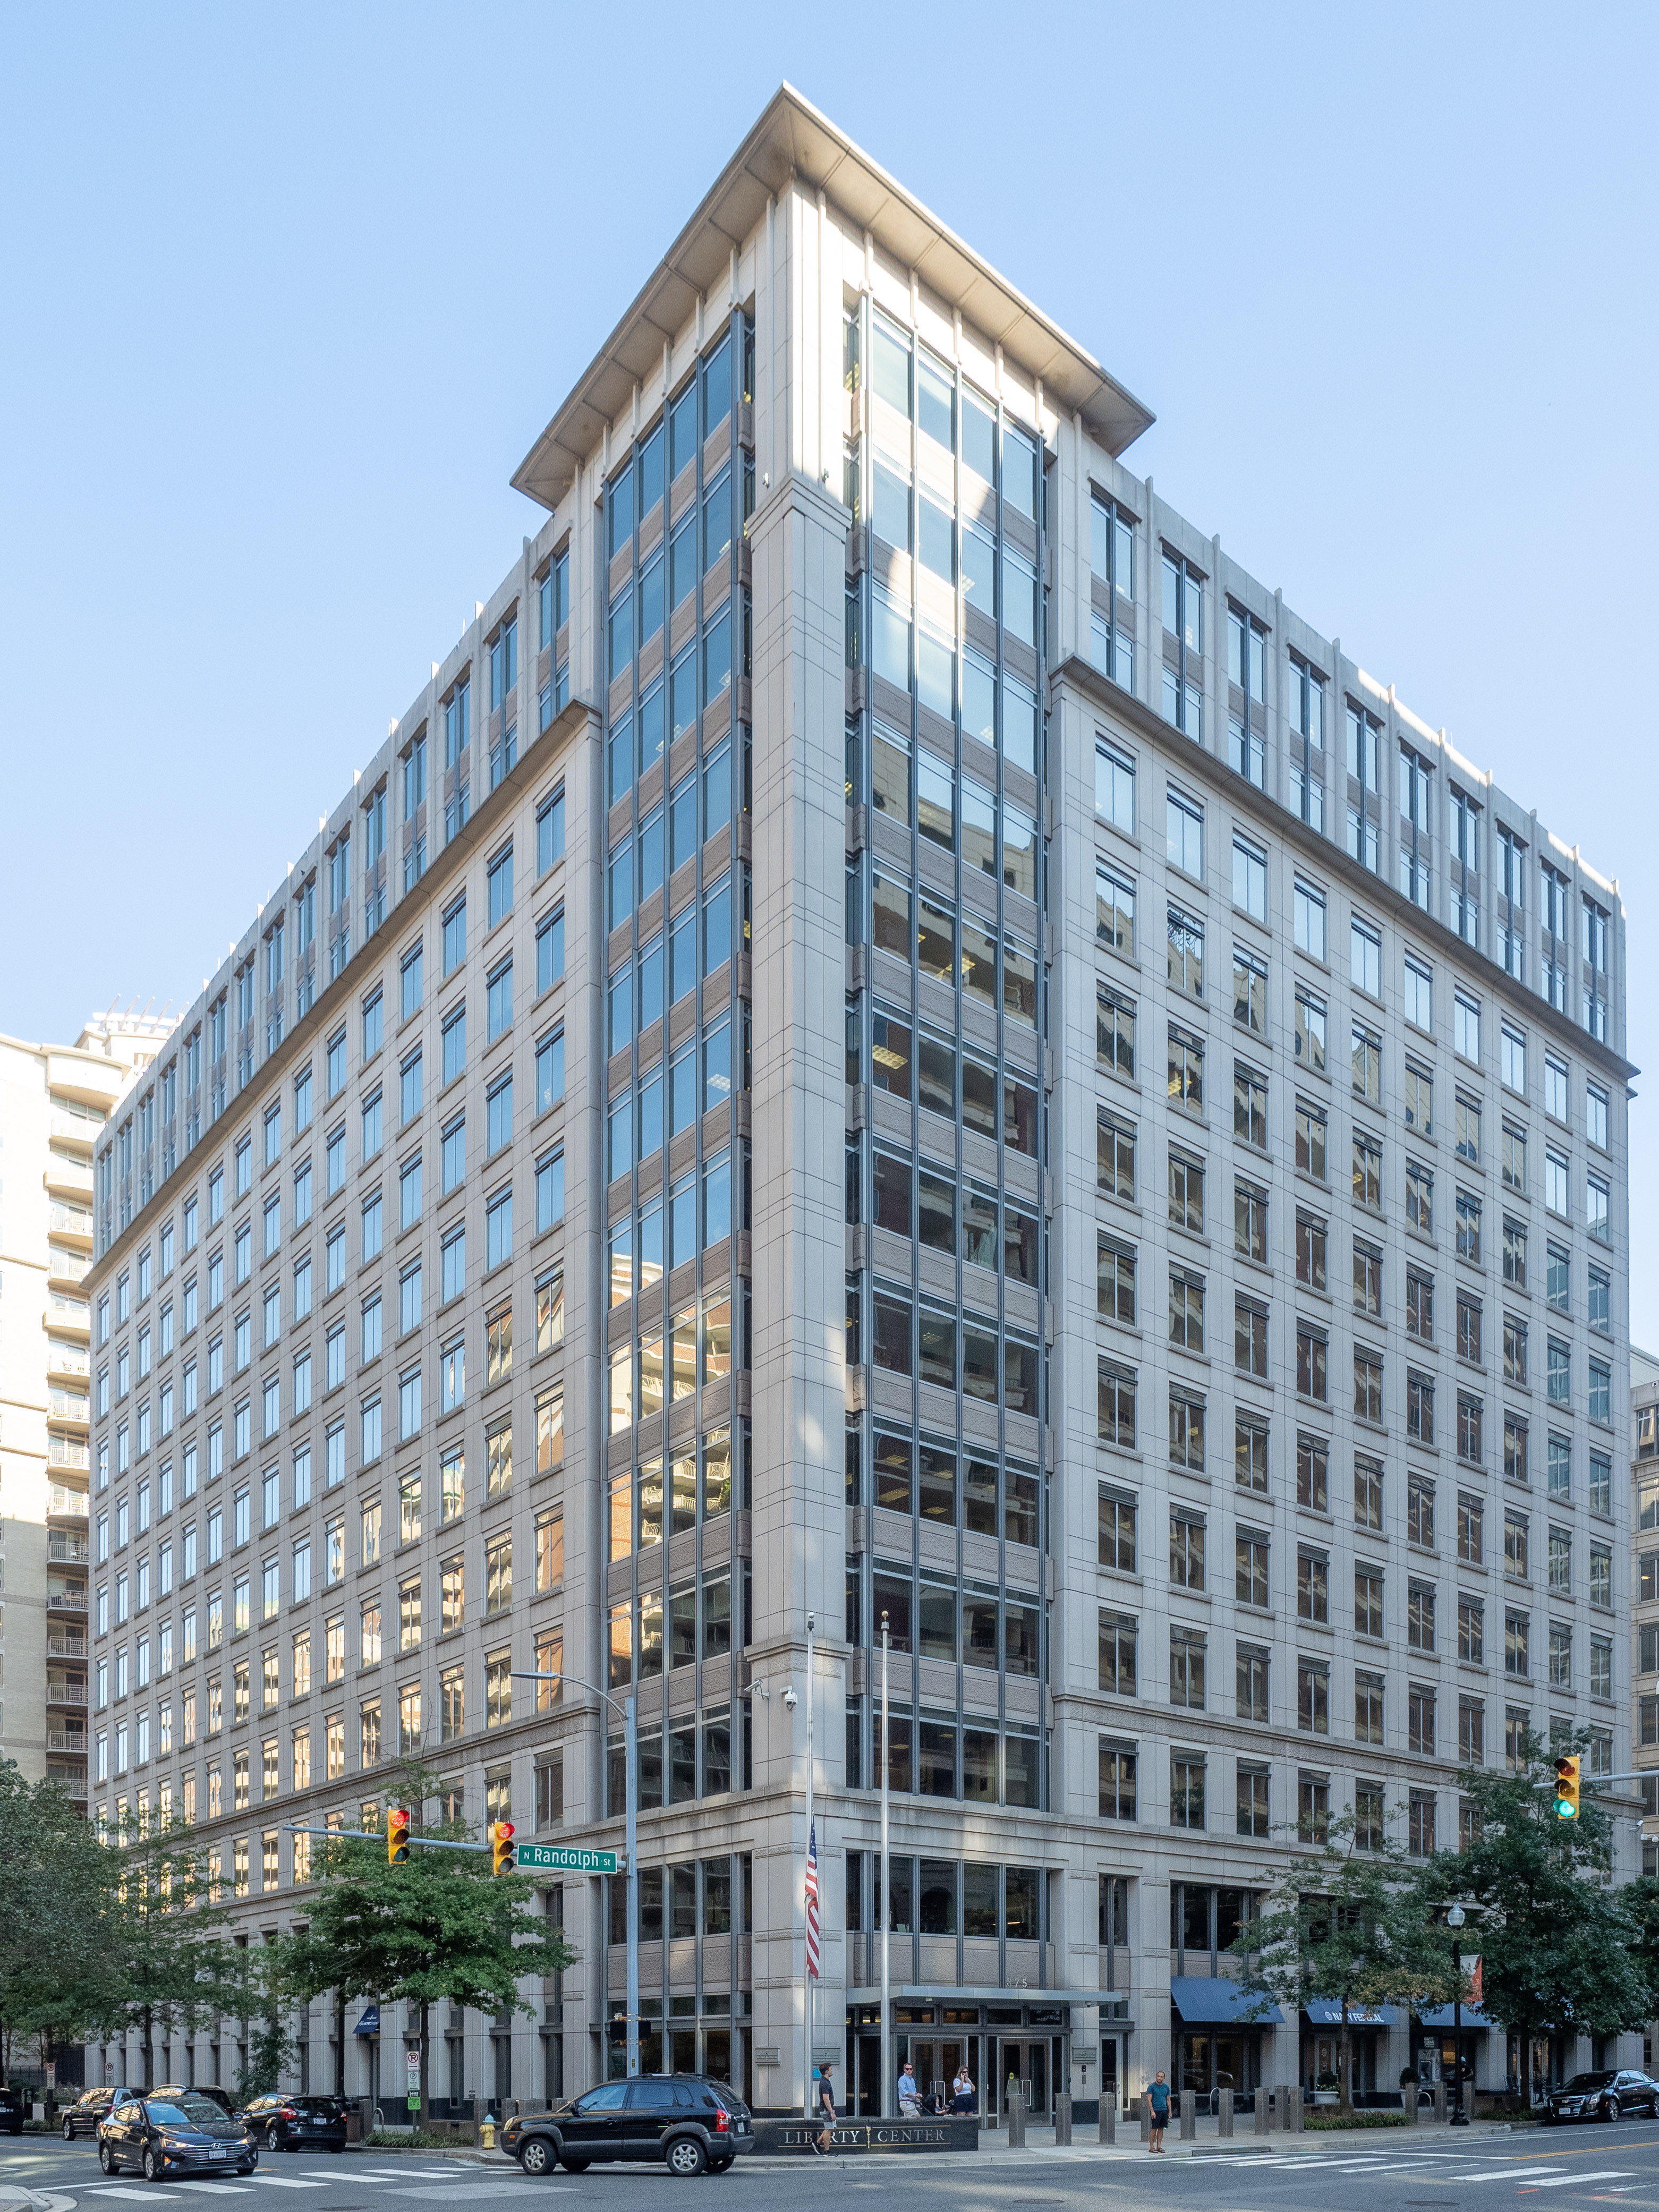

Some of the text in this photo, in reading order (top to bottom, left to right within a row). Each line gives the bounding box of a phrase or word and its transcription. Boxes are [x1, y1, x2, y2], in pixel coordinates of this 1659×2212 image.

[534, 1848, 599, 1869] Randolph
[1007, 1978, 1027, 1987] 875
[1332, 2012, 1353, 2021] NAY
[878, 2129, 946, 2142] CENTER
